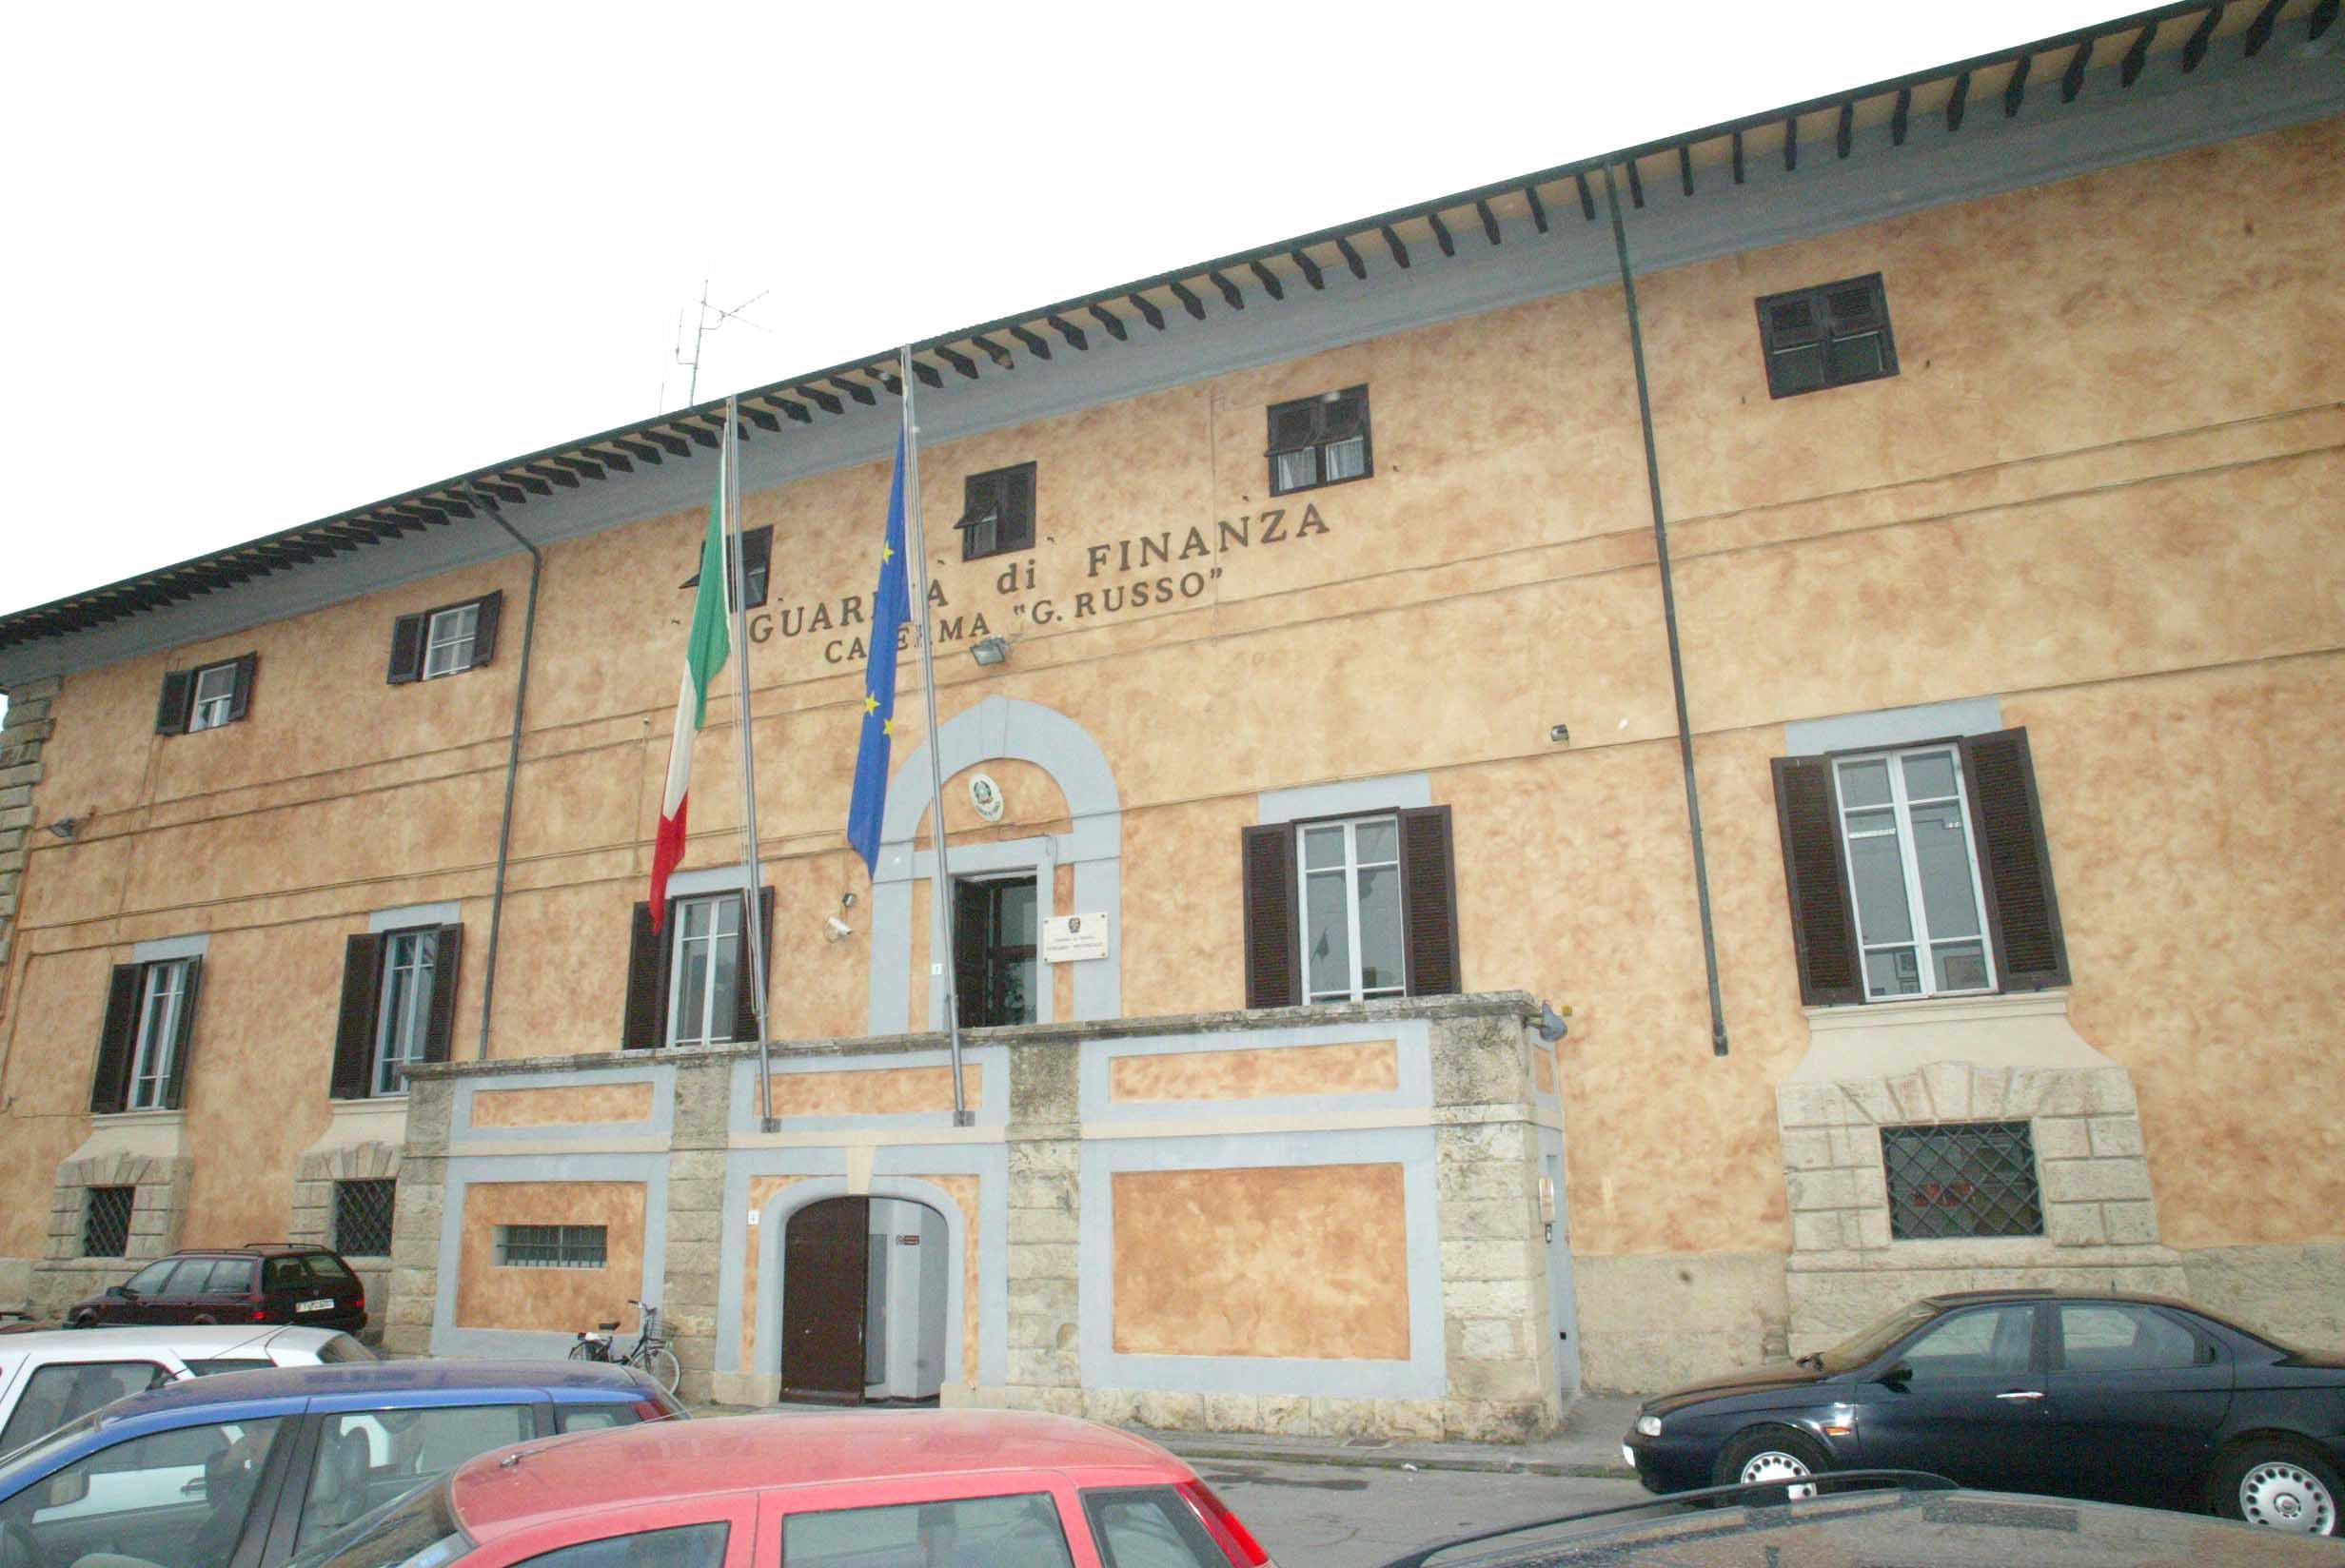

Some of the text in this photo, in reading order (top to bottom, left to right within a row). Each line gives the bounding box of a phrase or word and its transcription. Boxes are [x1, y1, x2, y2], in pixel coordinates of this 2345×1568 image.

[748, 502, 1330, 643] GUARA di FINANZA
